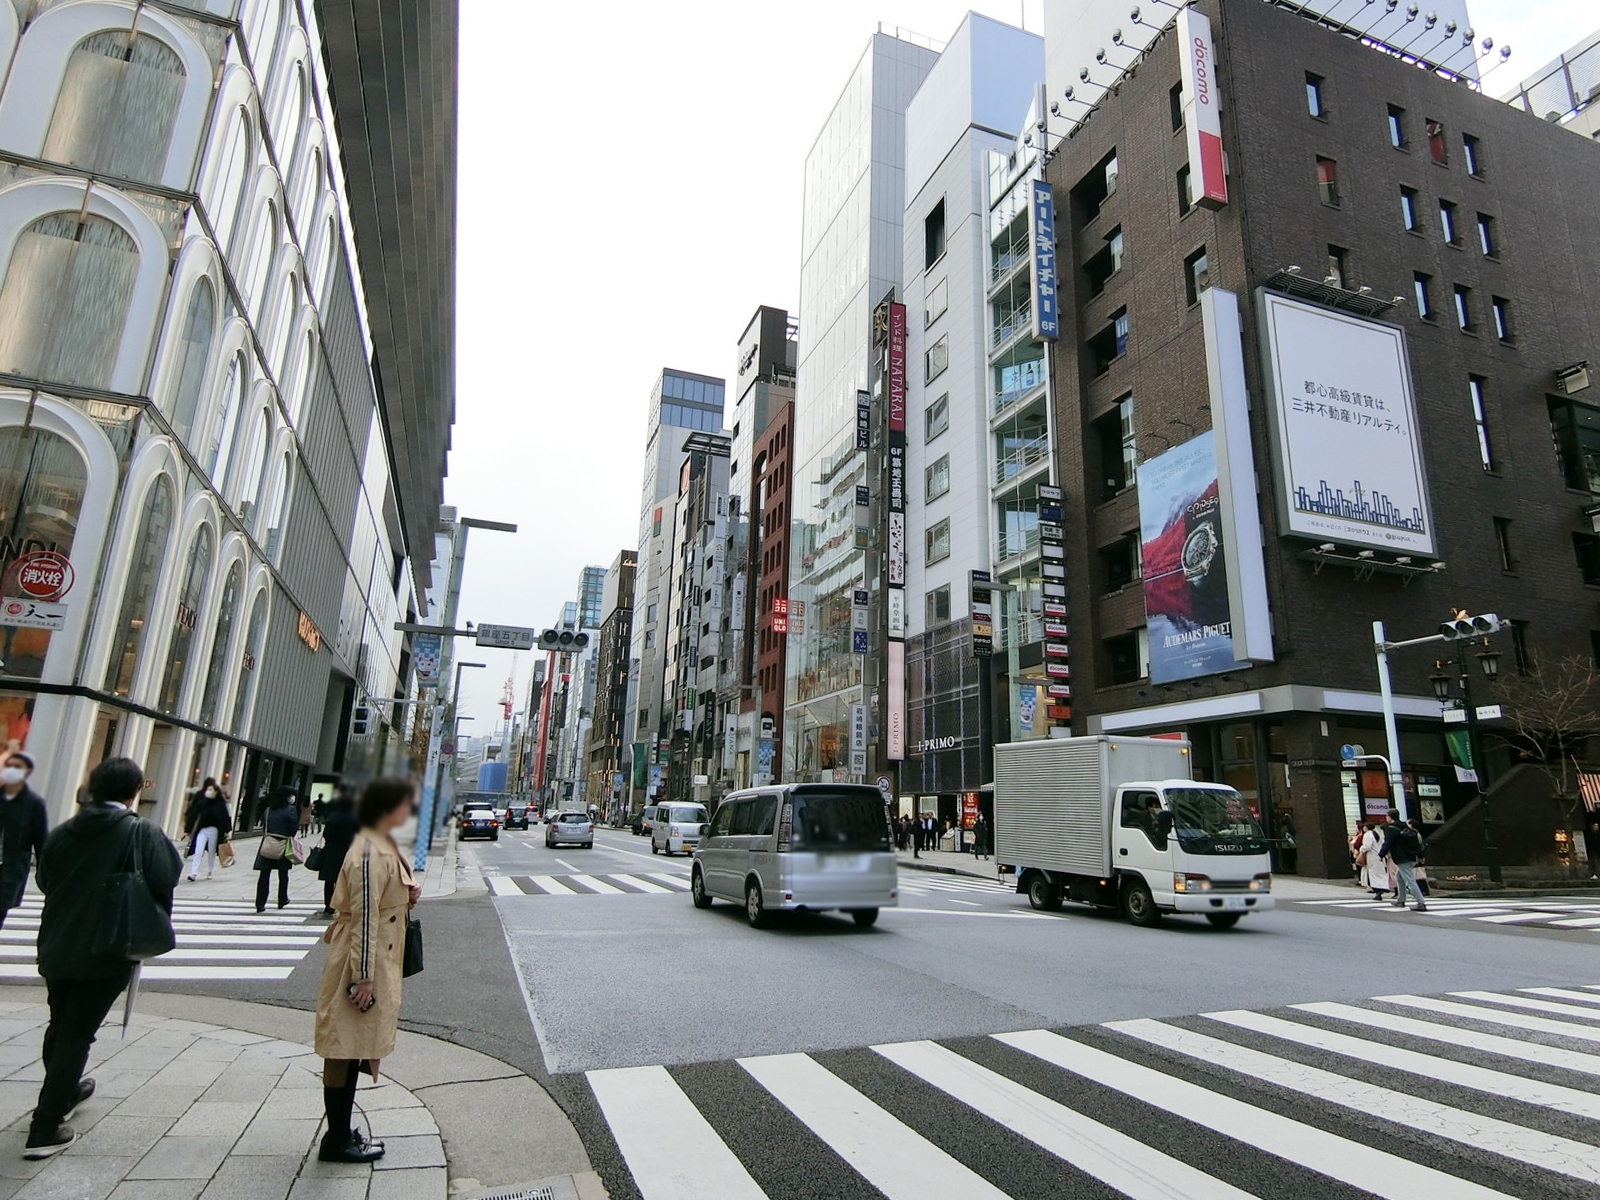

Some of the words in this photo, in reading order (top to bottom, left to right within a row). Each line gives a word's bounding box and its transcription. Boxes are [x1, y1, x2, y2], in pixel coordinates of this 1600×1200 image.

[1194, 37, 1209, 105] docomo
[1042, 321, 1055, 331] 6F
[891, 357, 903, 421] NATARAJ
[1304, 380, 1391, 412] 都心高級賃貸は、
[1292, 397, 1407, 436] 三井不動産リアルティ。
[891, 447, 902, 456] 6F
[23, 568, 62, 587] 消火栓
[481, 629, 530, 641] 銀座五丁目
[1163, 628, 1202, 648] AUDEMARS
[1203, 621, 1231, 639] PIGUET
[918, 736, 955, 751] I-PRIMO
[1366, 802, 1388, 810] docomo
[1214, 844, 1243, 852] ISUZU
